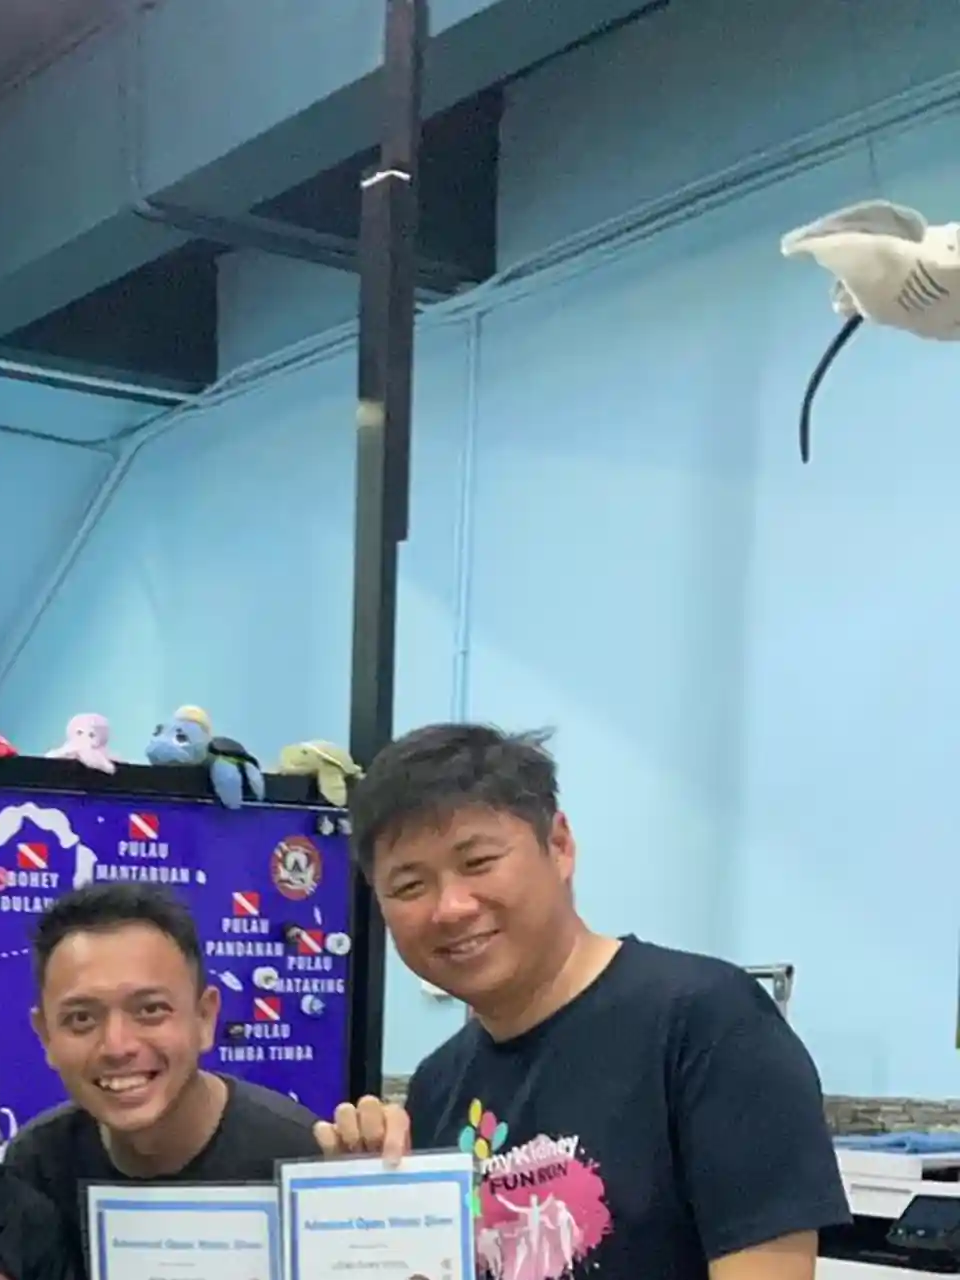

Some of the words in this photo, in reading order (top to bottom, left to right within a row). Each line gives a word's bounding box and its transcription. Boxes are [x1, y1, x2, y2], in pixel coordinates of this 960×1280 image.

[118, 841, 169, 859] PULAU
[96, 864, 190, 883] MANTABUAN
[222, 917, 270, 934] PULAU
[205, 941, 284, 957] PANDANAN
[287, 955, 333, 972] PULAU
[243, 1023, 291, 1039] PULAU
[218, 1046, 264, 1062] TIMBA
[269, 1045, 314, 1061] TIMBA
[489, 1170, 535, 1195] FUN
